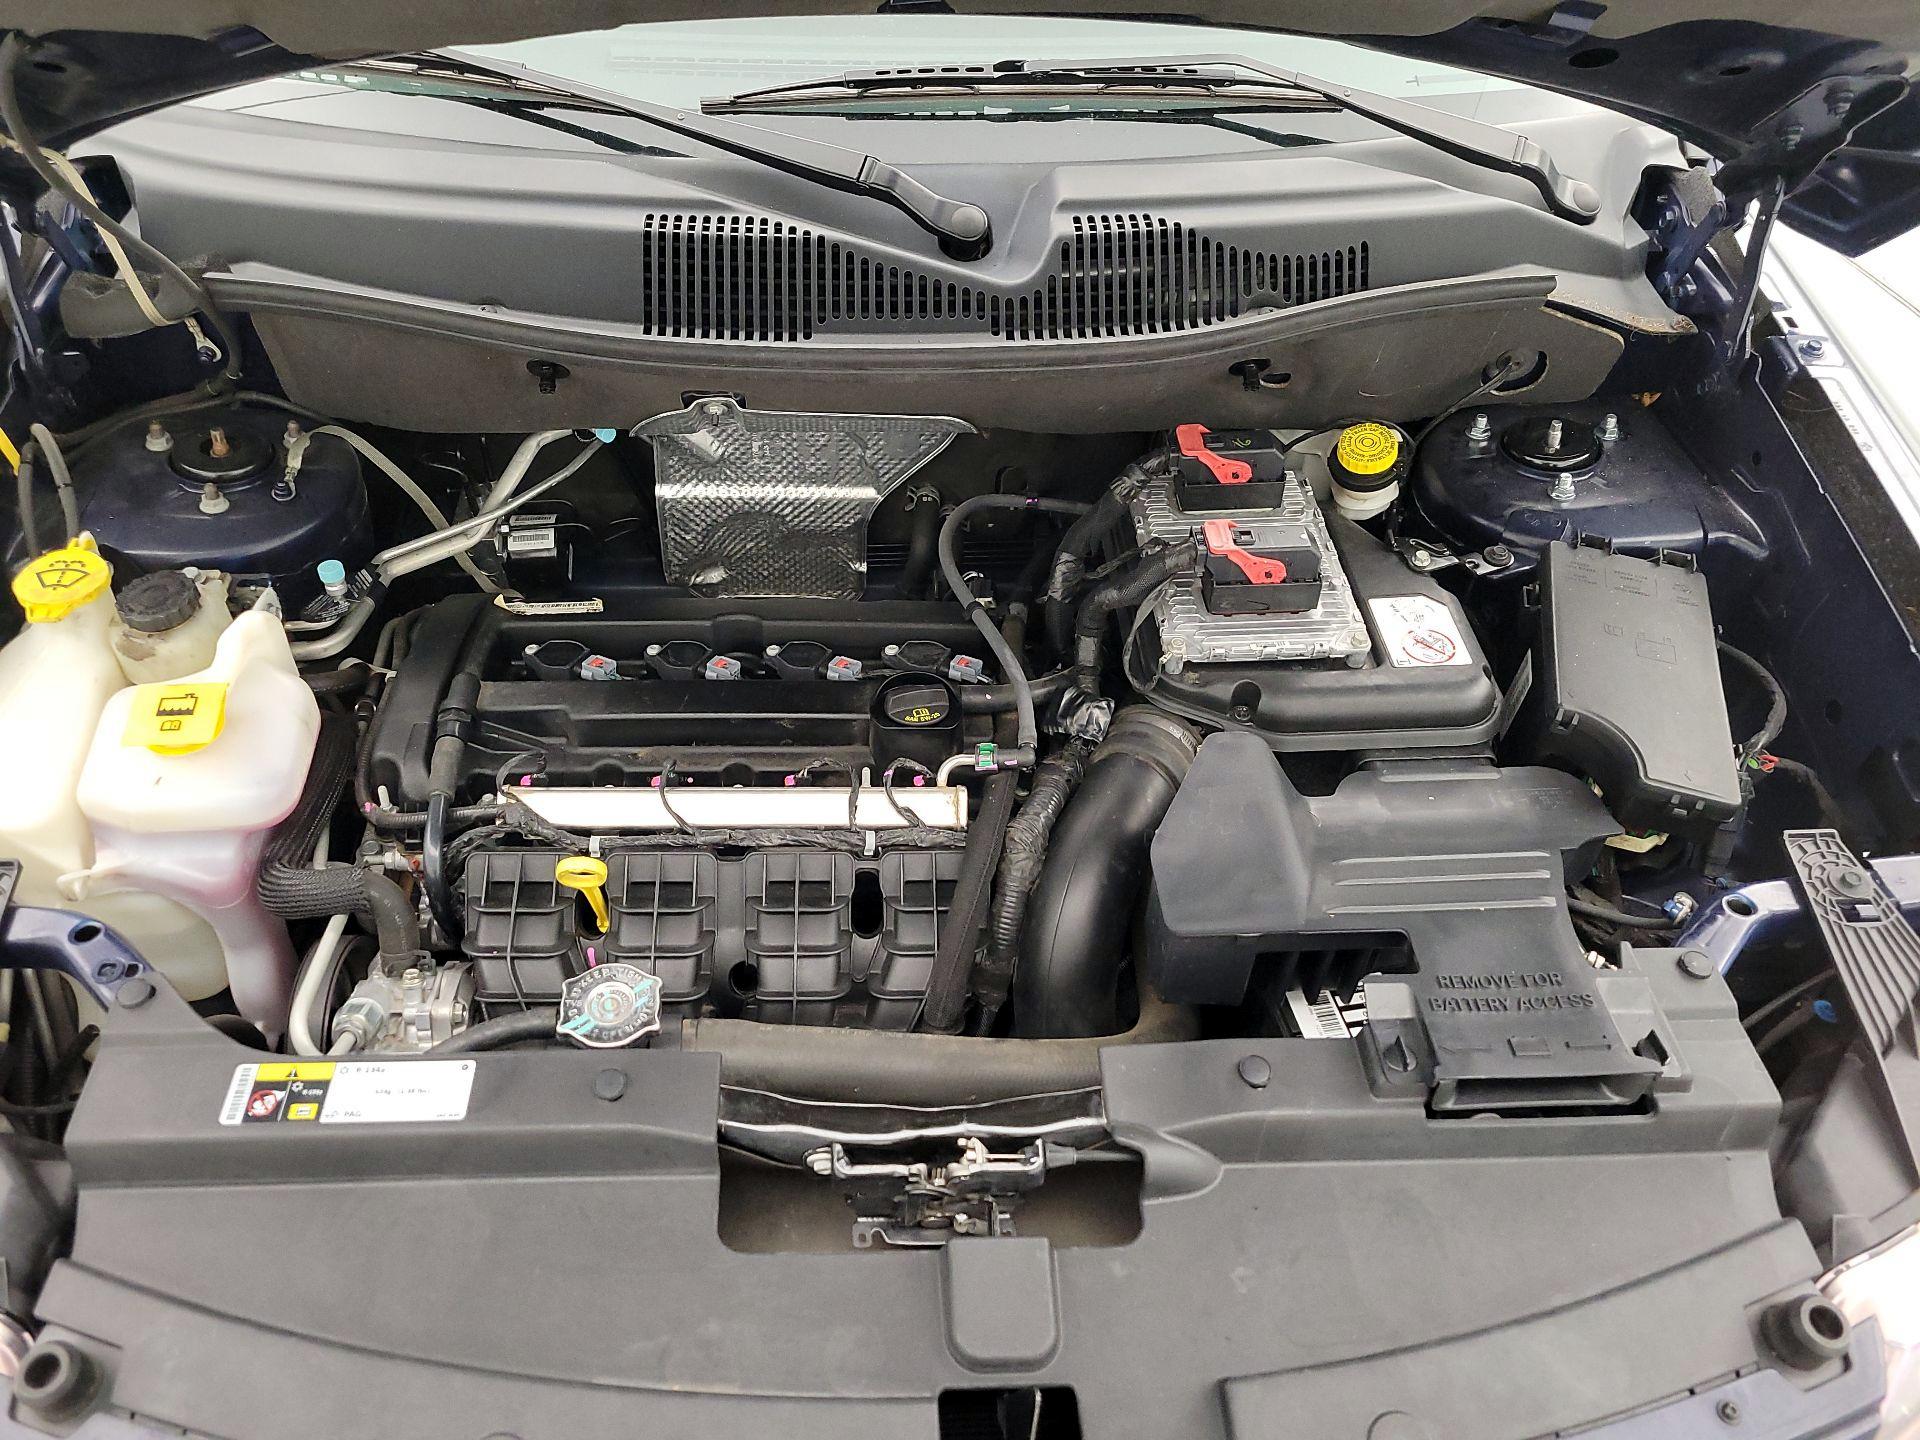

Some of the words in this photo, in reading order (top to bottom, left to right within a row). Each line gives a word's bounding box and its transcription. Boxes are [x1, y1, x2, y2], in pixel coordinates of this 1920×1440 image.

[1437, 973, 1519, 989] REMOVE
[1521, 972, 1563, 988] FOR
[1428, 997, 1510, 1012] BATTERY
[1517, 993, 1596, 1012] ACCESS
